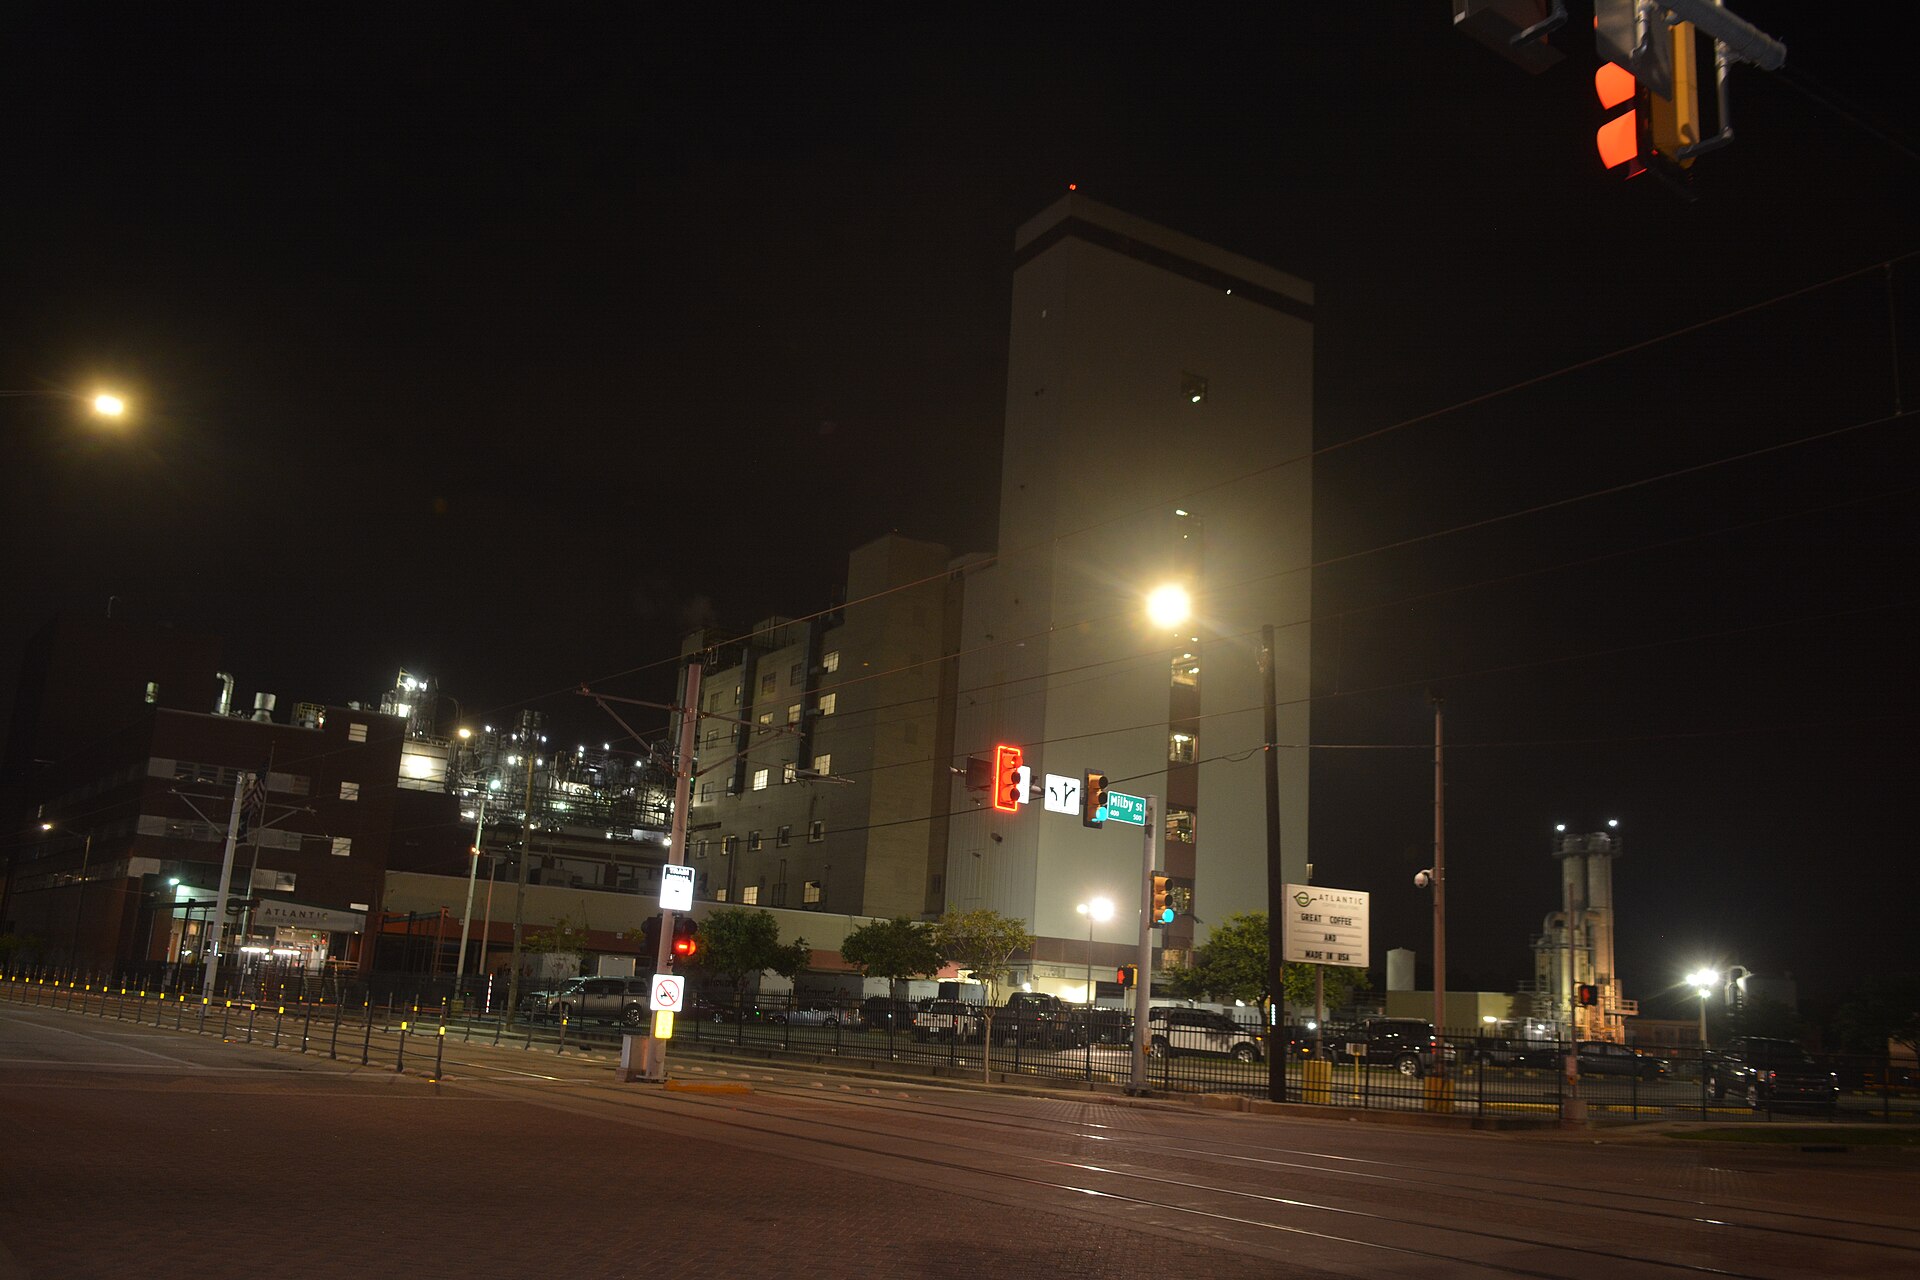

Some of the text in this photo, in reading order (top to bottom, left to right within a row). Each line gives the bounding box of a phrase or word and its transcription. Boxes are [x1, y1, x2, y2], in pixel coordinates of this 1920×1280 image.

[1110, 795, 1143, 812] Milby St
[1319, 894, 1363, 905] ATLANTIC
[265, 908, 329, 919] ATLANTIC
[1301, 913, 1352, 926] GREAT COFFEE
[1324, 934, 1336, 942] AND
[1305, 950, 1349, 961] MADE IN USA
